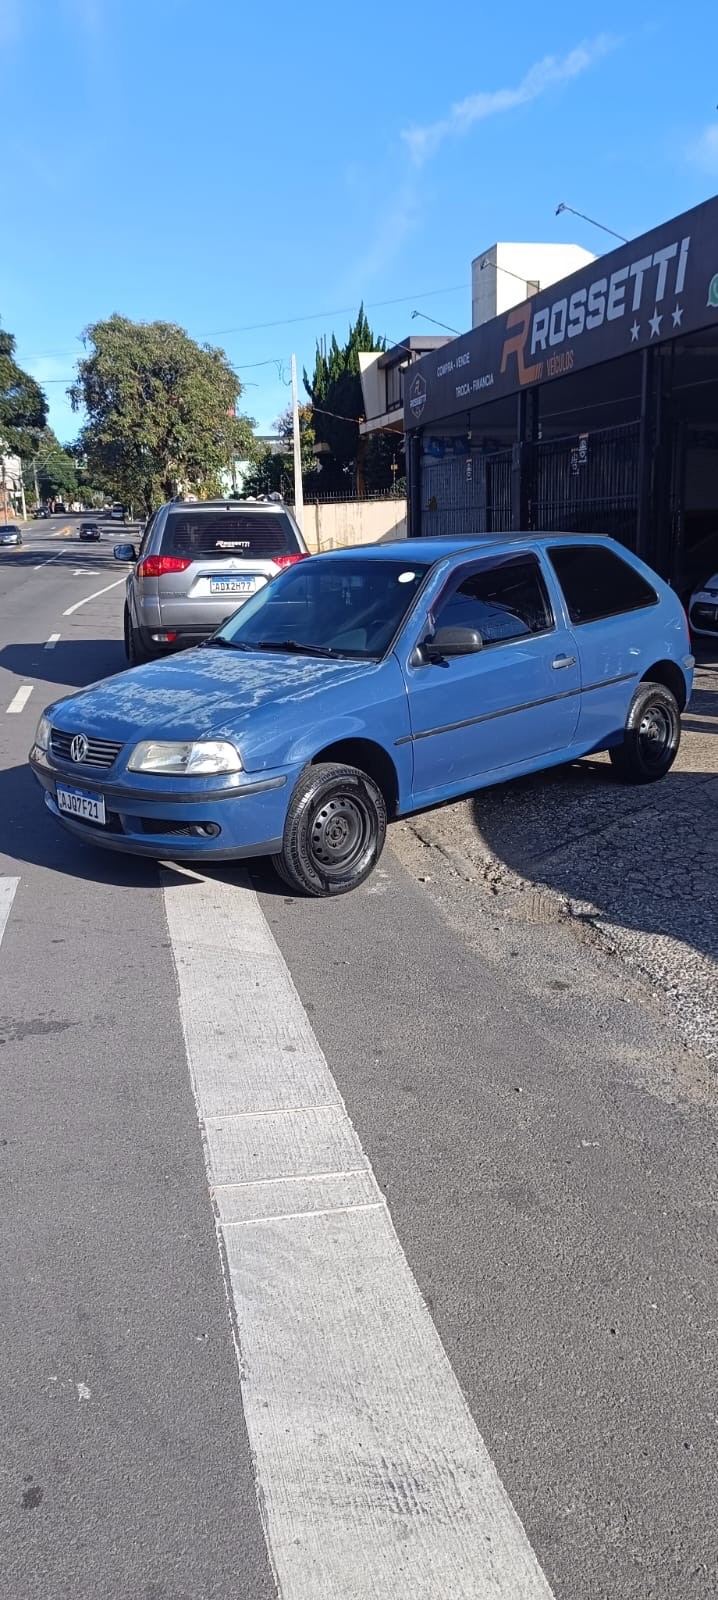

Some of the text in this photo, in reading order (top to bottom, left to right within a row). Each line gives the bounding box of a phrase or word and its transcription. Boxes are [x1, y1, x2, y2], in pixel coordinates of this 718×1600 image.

[530, 236, 691, 356] ROSSETTI
[437, 352, 470, 376] COMPRA VENDE
[546, 349, 575, 377] VEÍCULOS
[455, 373, 494, 398] TROCA FINANCIA
[215, 582, 251, 591] ADX2H77
[61, 792, 98, 819] AJQ7F21
